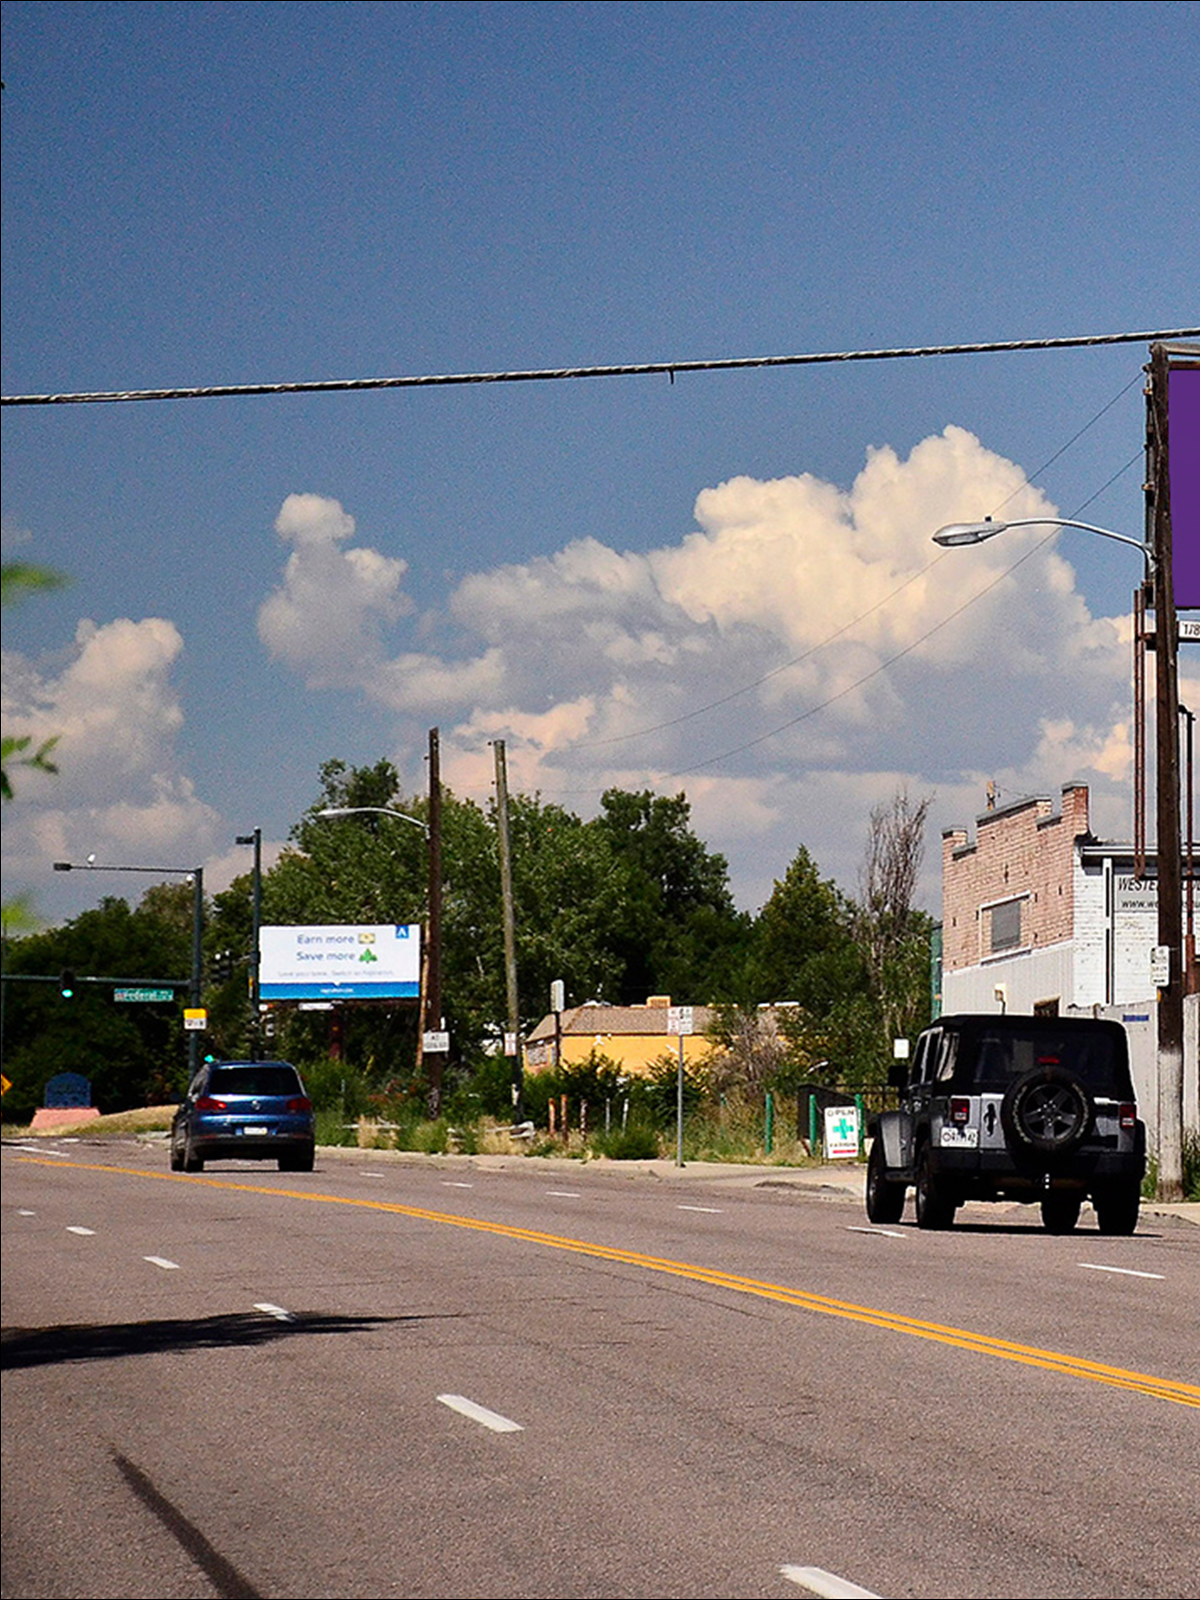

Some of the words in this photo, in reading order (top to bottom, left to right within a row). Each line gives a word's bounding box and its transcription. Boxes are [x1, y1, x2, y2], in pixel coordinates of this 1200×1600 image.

[1118, 877, 1161, 891] WESTE
[296, 934, 323, 944] Earn
[326, 936, 355, 944] more
[296, 951, 324, 961] Save
[326, 953, 356, 961] more
[827, 1109, 854, 1117] OPEN
